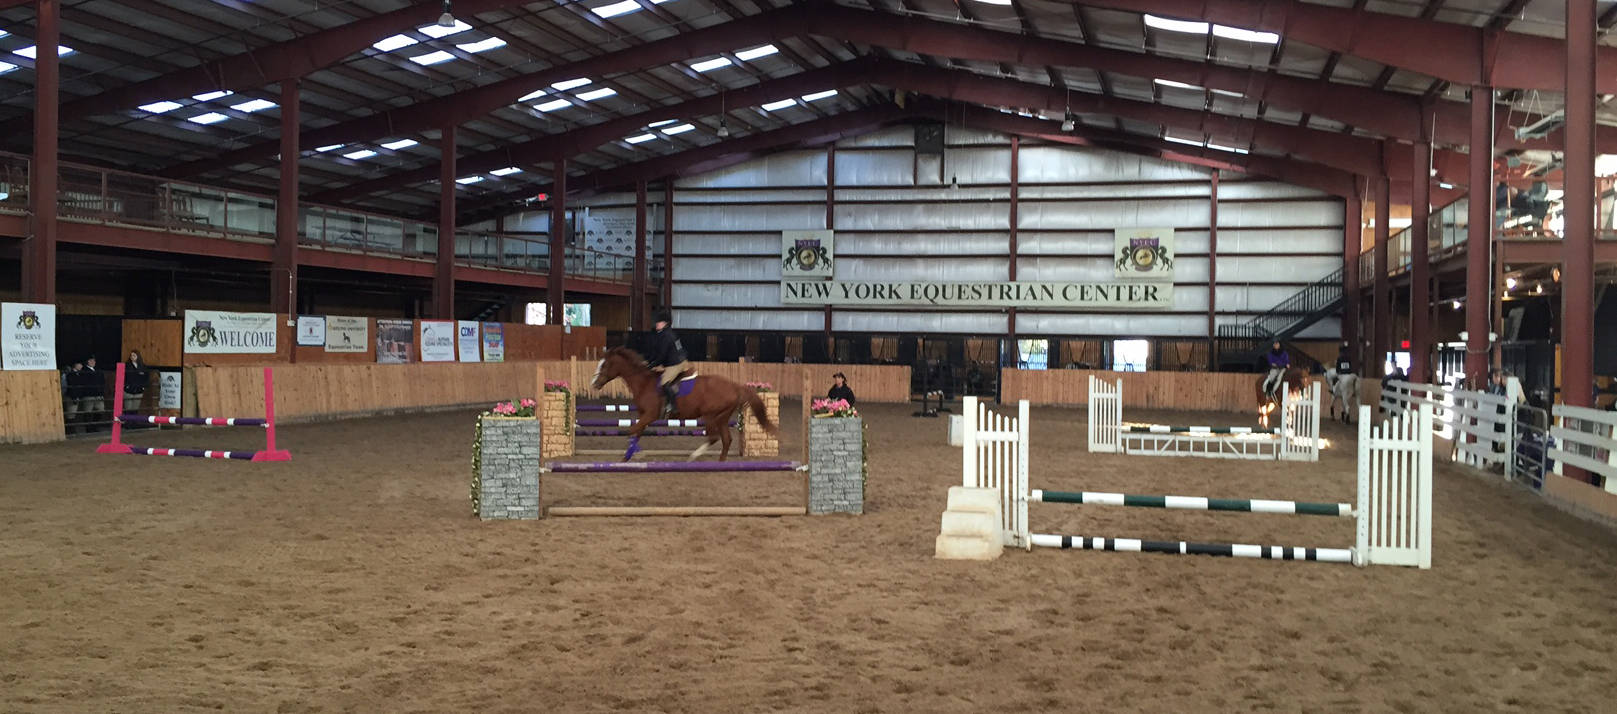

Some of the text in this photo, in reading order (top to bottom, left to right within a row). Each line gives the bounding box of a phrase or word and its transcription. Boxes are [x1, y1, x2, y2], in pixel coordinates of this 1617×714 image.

[785, 283, 1159, 305] NEW YORK EQUESTRIAN CENTER
[219, 331, 275, 347] WELCOME
